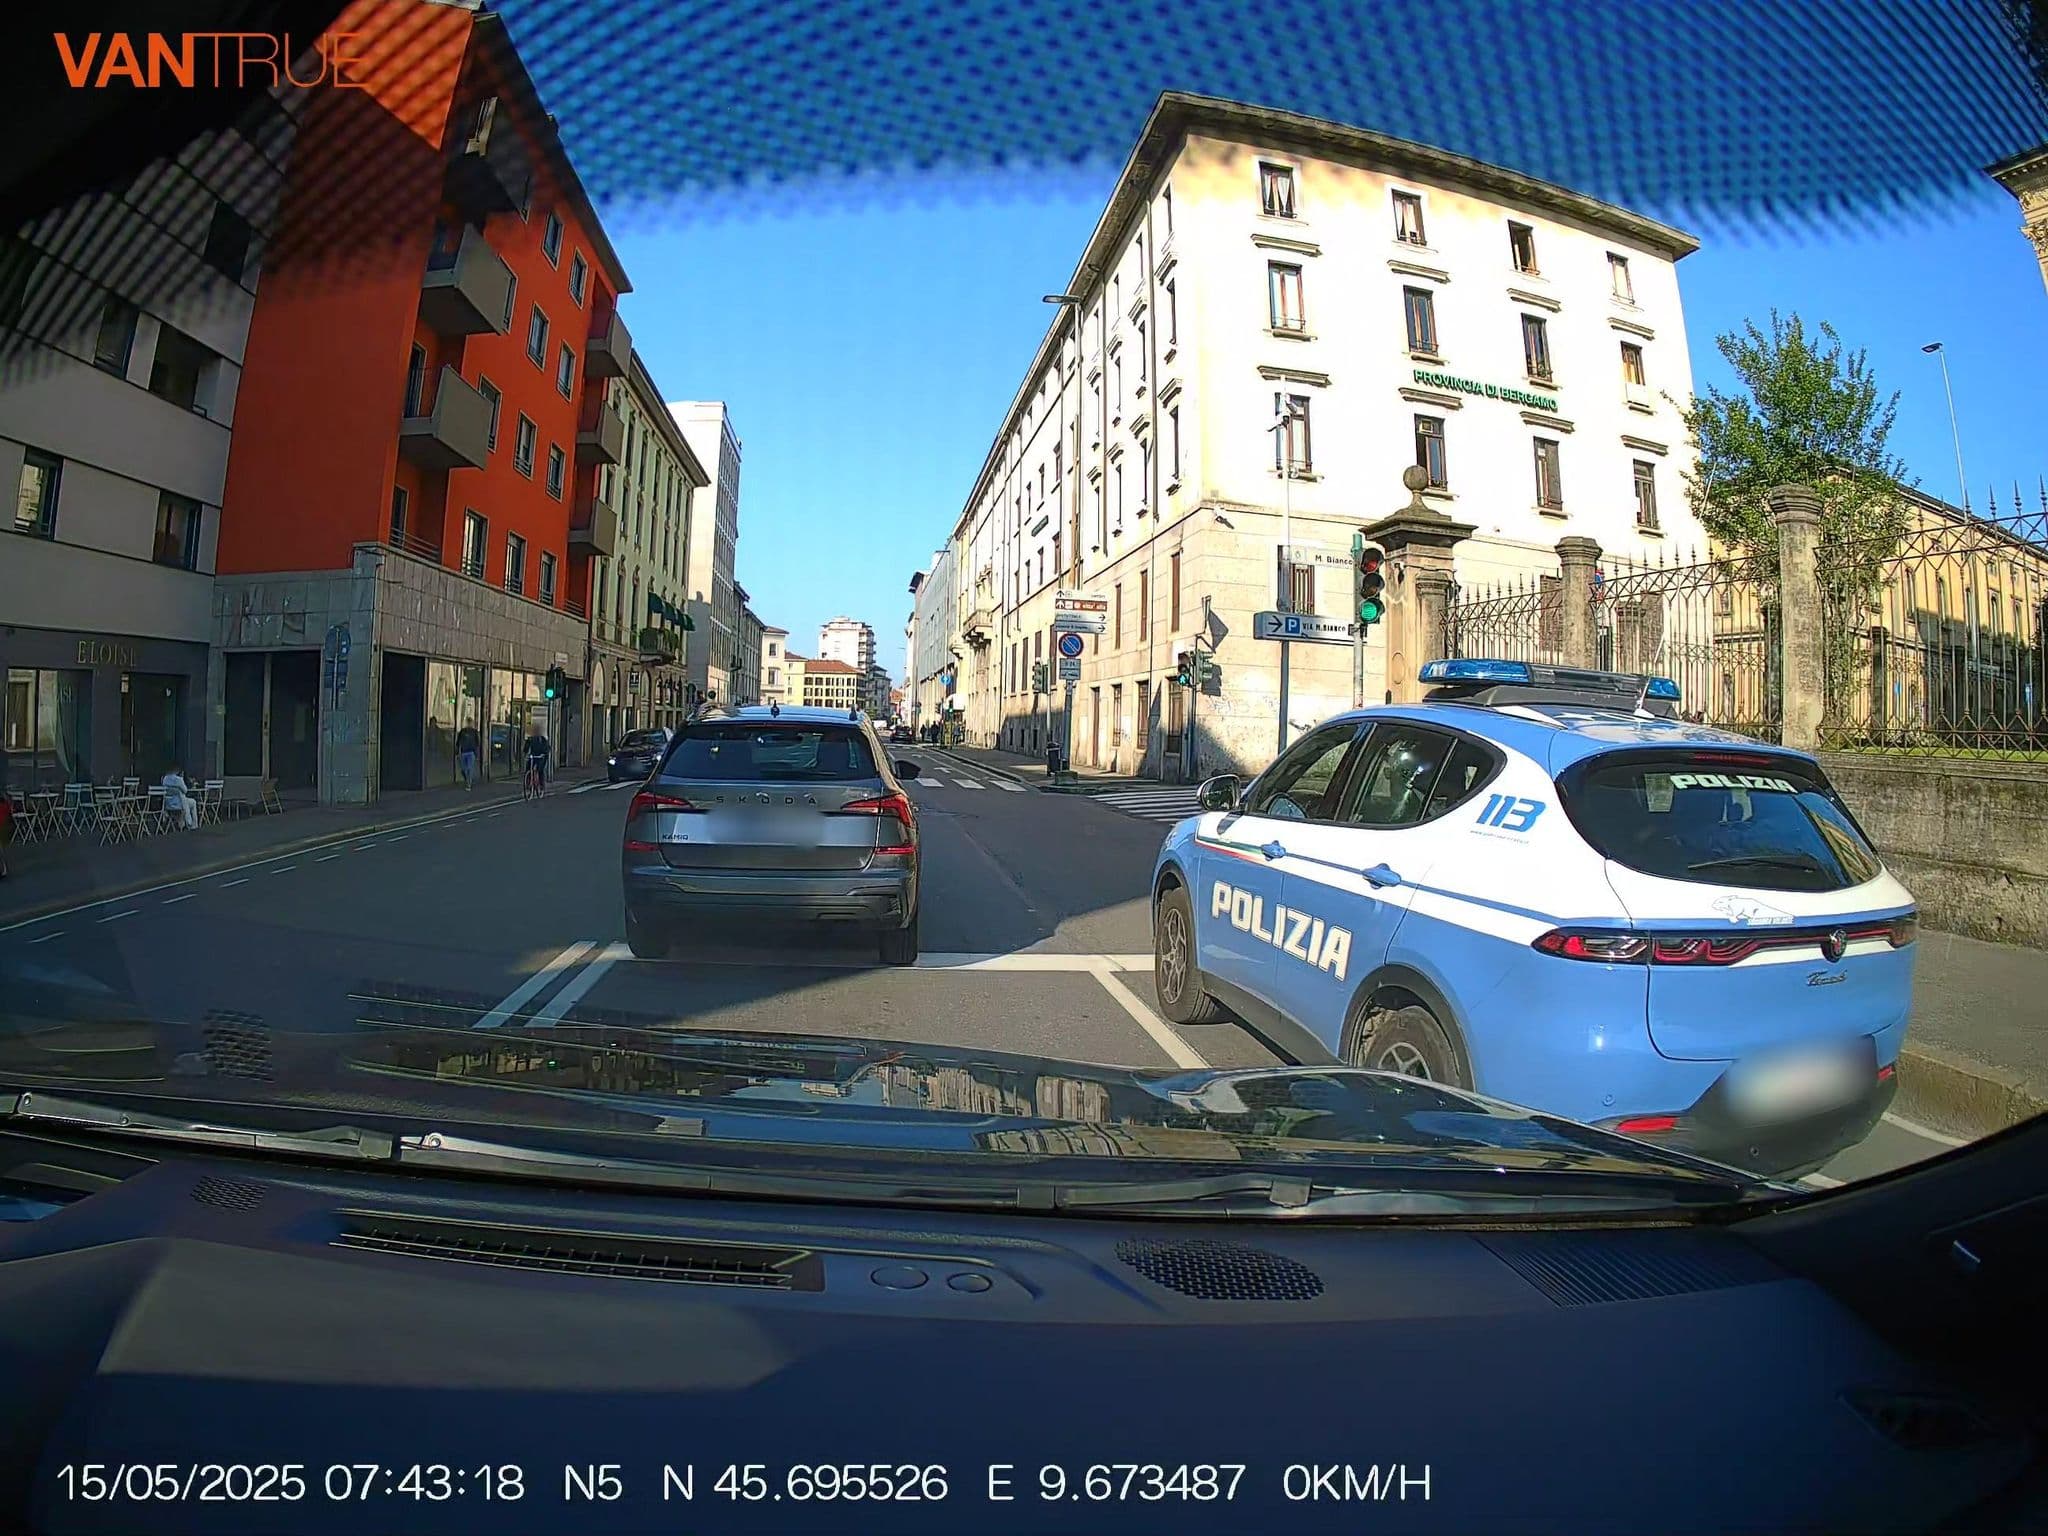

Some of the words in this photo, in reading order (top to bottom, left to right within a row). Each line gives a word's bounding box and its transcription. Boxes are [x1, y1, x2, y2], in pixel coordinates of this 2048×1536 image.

[1414, 369, 1484, 396] PROVINCIA
[1485, 383, 1497, 399] DI
[1500, 387, 1558, 412] BERGAMO
[1288, 619, 1297, 632] P
[1670, 774, 1799, 794] POLIZIA
[1476, 793, 1546, 832] 113
[662, 833, 689, 841] KAMIQ
[1211, 880, 1352, 982] POLIZIA
